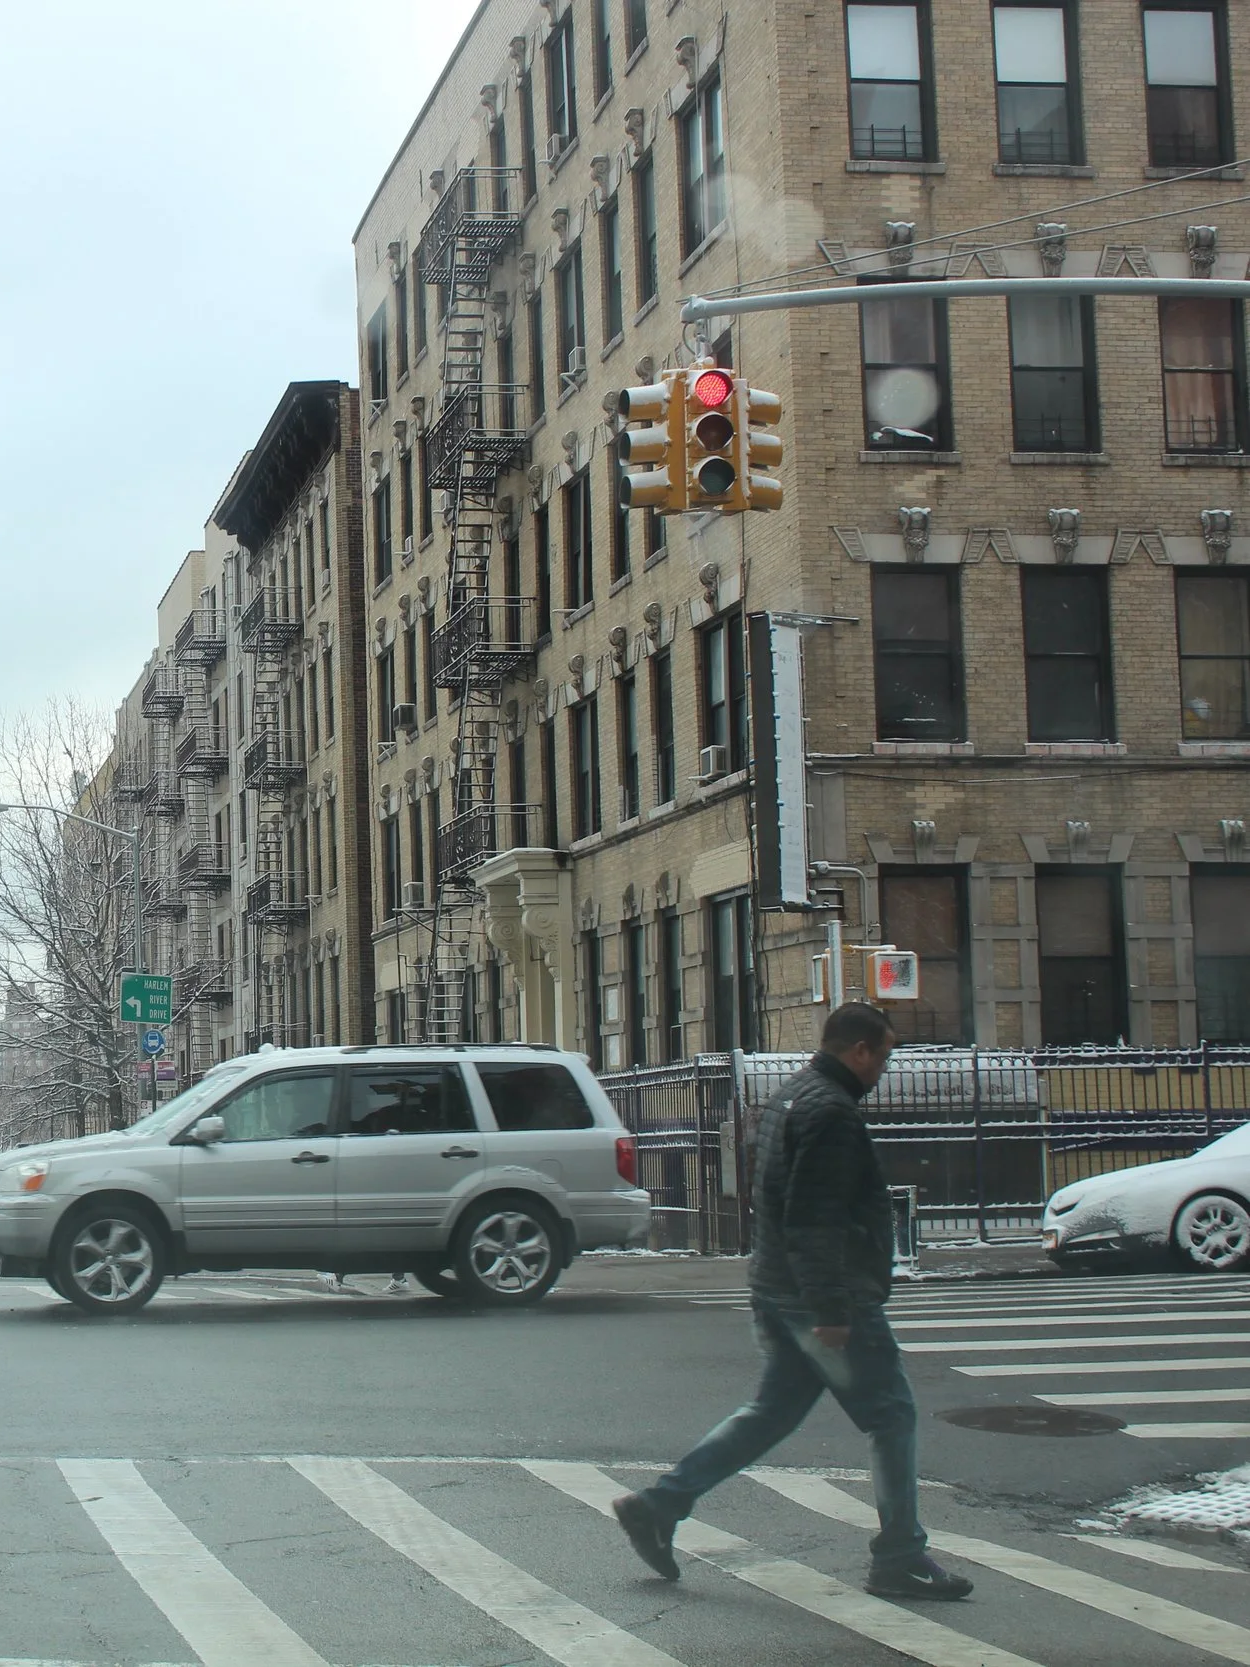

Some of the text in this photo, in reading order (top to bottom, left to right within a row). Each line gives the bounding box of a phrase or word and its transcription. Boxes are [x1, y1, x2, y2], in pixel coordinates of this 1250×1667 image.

[144, 980, 169, 990] HARLEM
[149, 995, 168, 1005] RIVER
[149, 1009, 168, 1020] DRIVE
